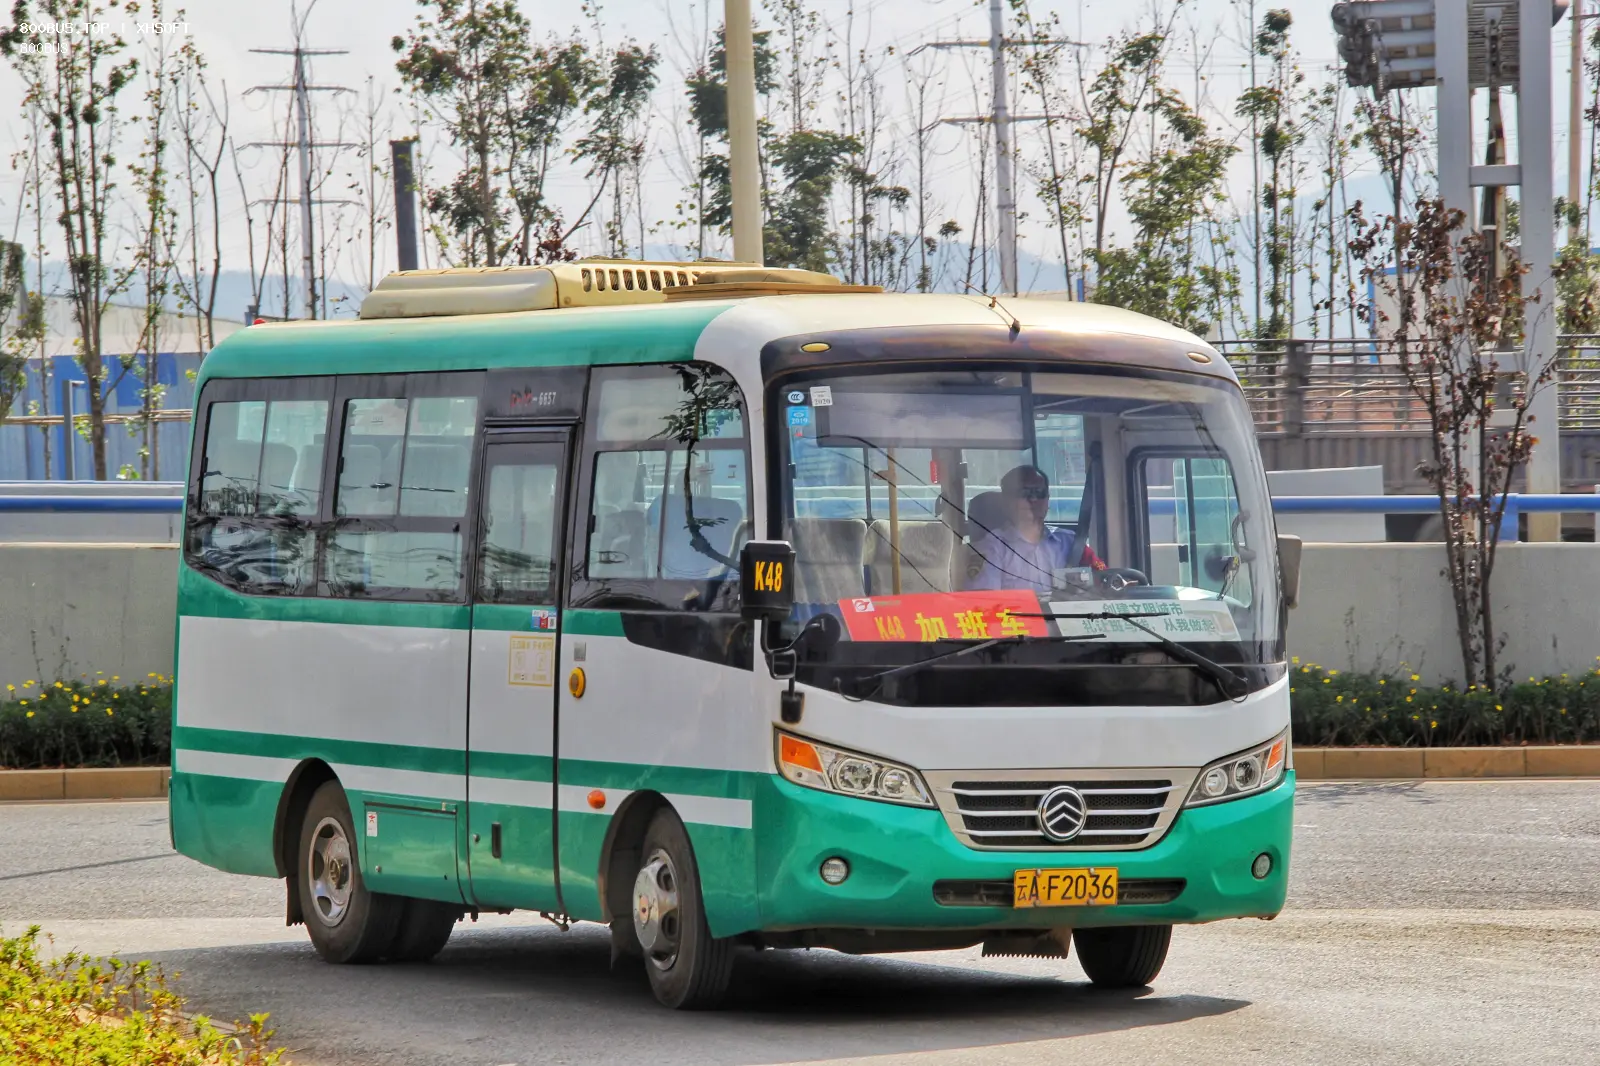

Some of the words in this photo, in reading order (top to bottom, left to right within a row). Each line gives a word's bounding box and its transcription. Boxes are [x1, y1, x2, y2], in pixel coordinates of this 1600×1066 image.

[814, 398, 831, 406] 2020
[791, 417, 808, 425] 2019
[754, 560, 783, 593] K48
[1102, 602, 1184, 617] 创建文明城市
[874, 615, 905, 641] K48
[914, 608, 1030, 642] 加班车
